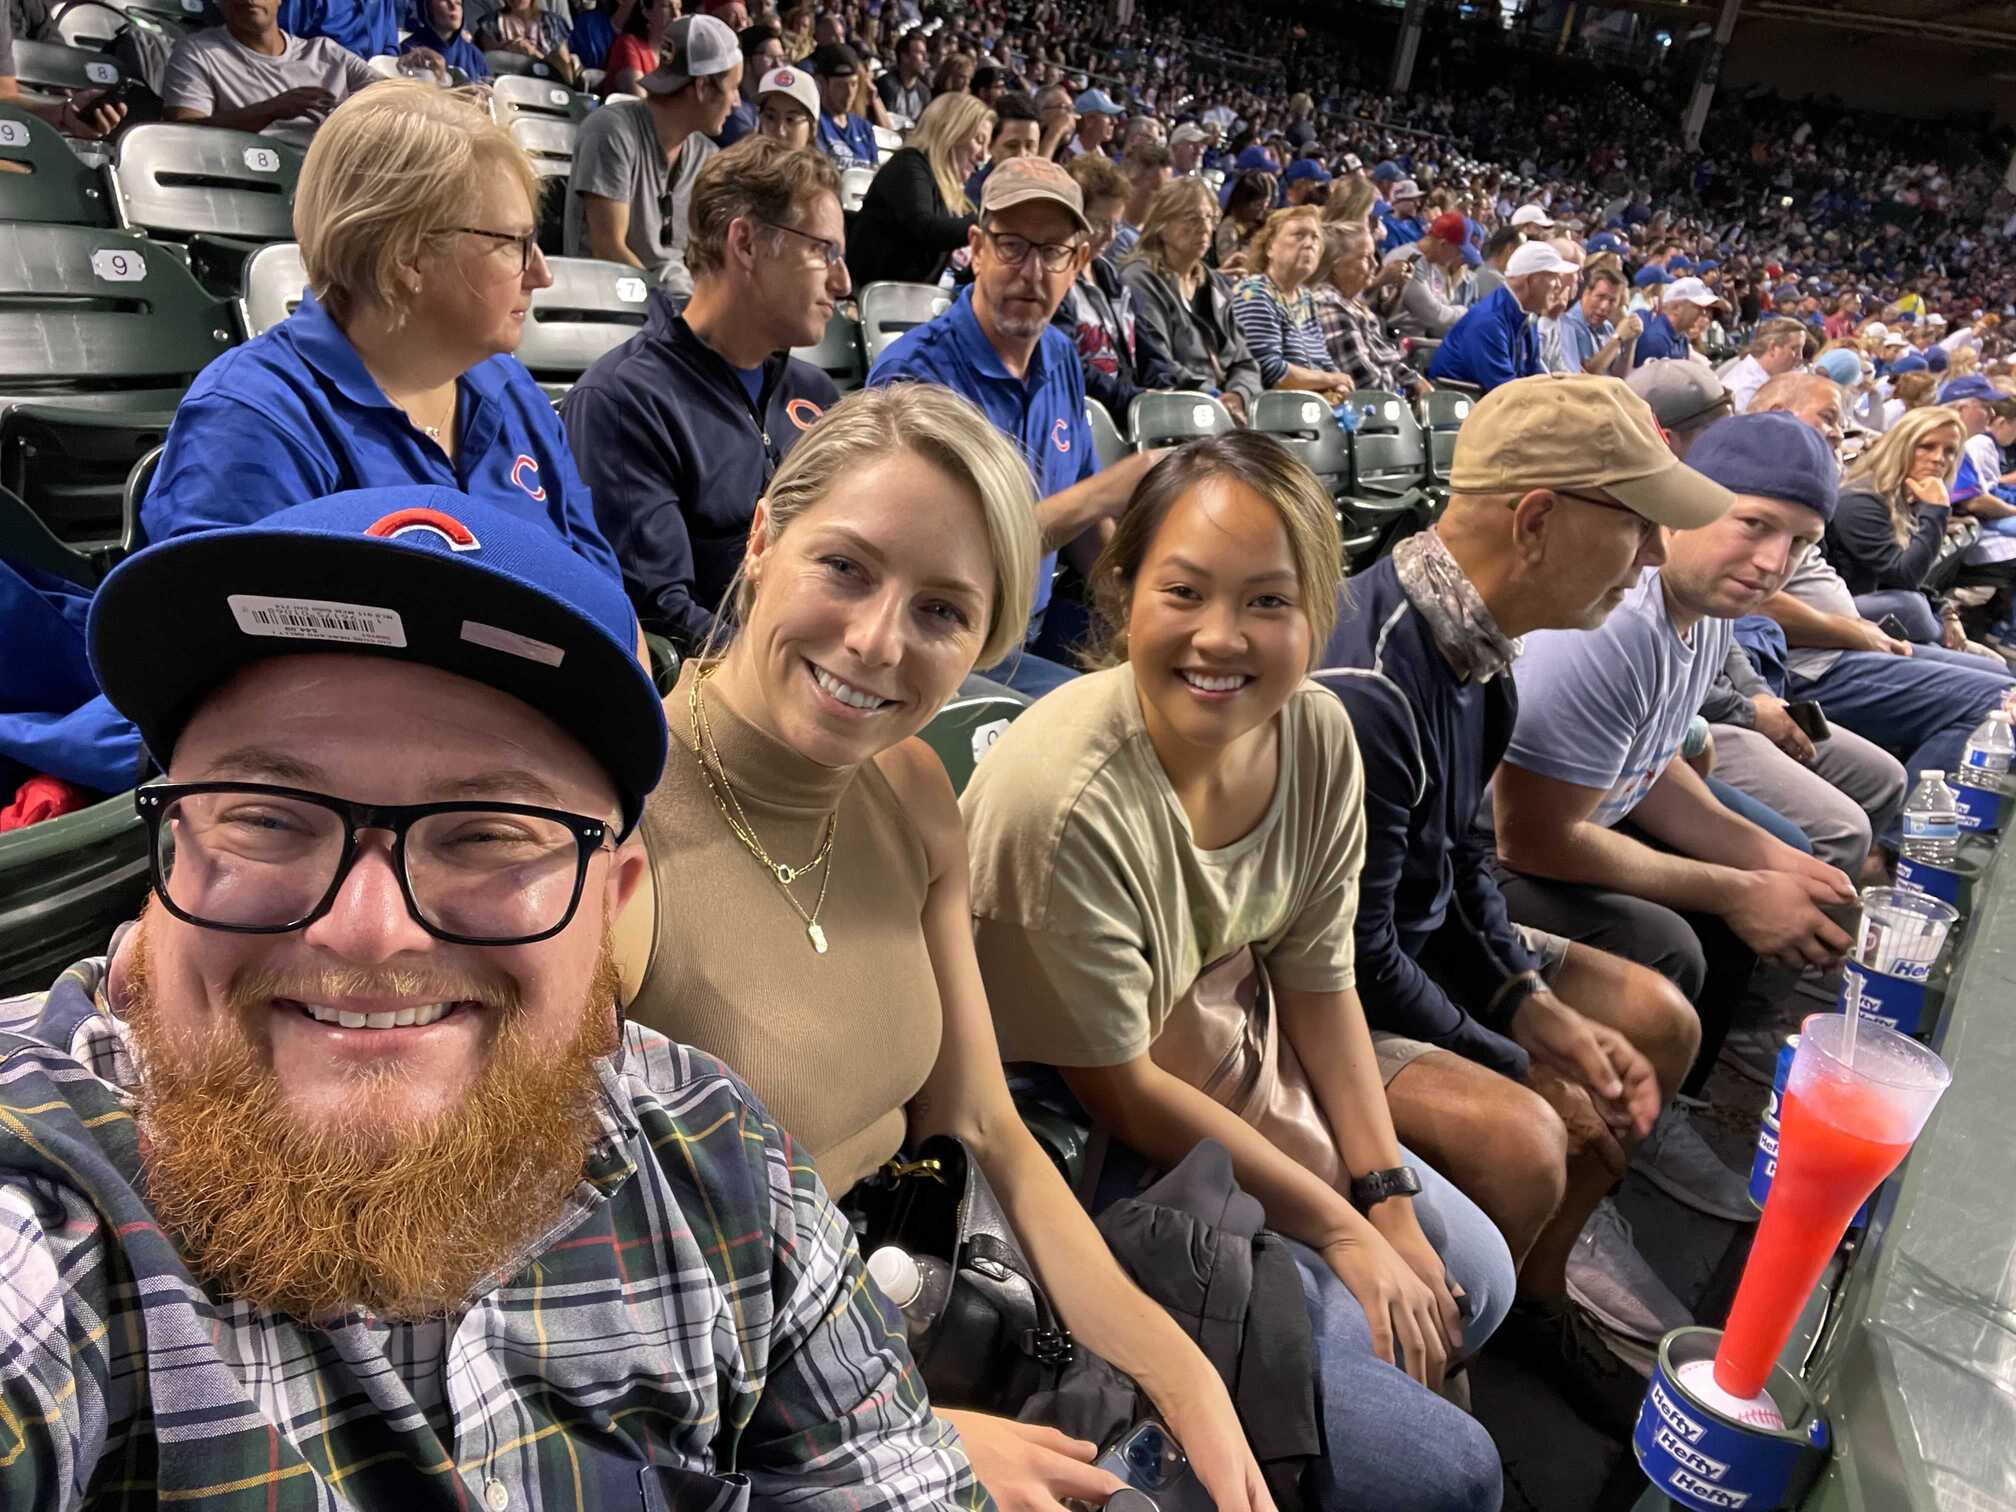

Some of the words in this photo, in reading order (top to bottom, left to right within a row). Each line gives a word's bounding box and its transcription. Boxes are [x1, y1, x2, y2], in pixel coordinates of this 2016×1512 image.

[1, 124, 15, 141] 9
[257, 152, 269, 167] 8
[112, 255, 128, 276] 9
[1051, 418, 1071, 453] C
[511, 454, 547, 502] C
[1653, 1387, 1699, 1441] Hefty
[1660, 1432, 1722, 1478] Hefty
[1675, 1473, 1744, 1509] Hefty
